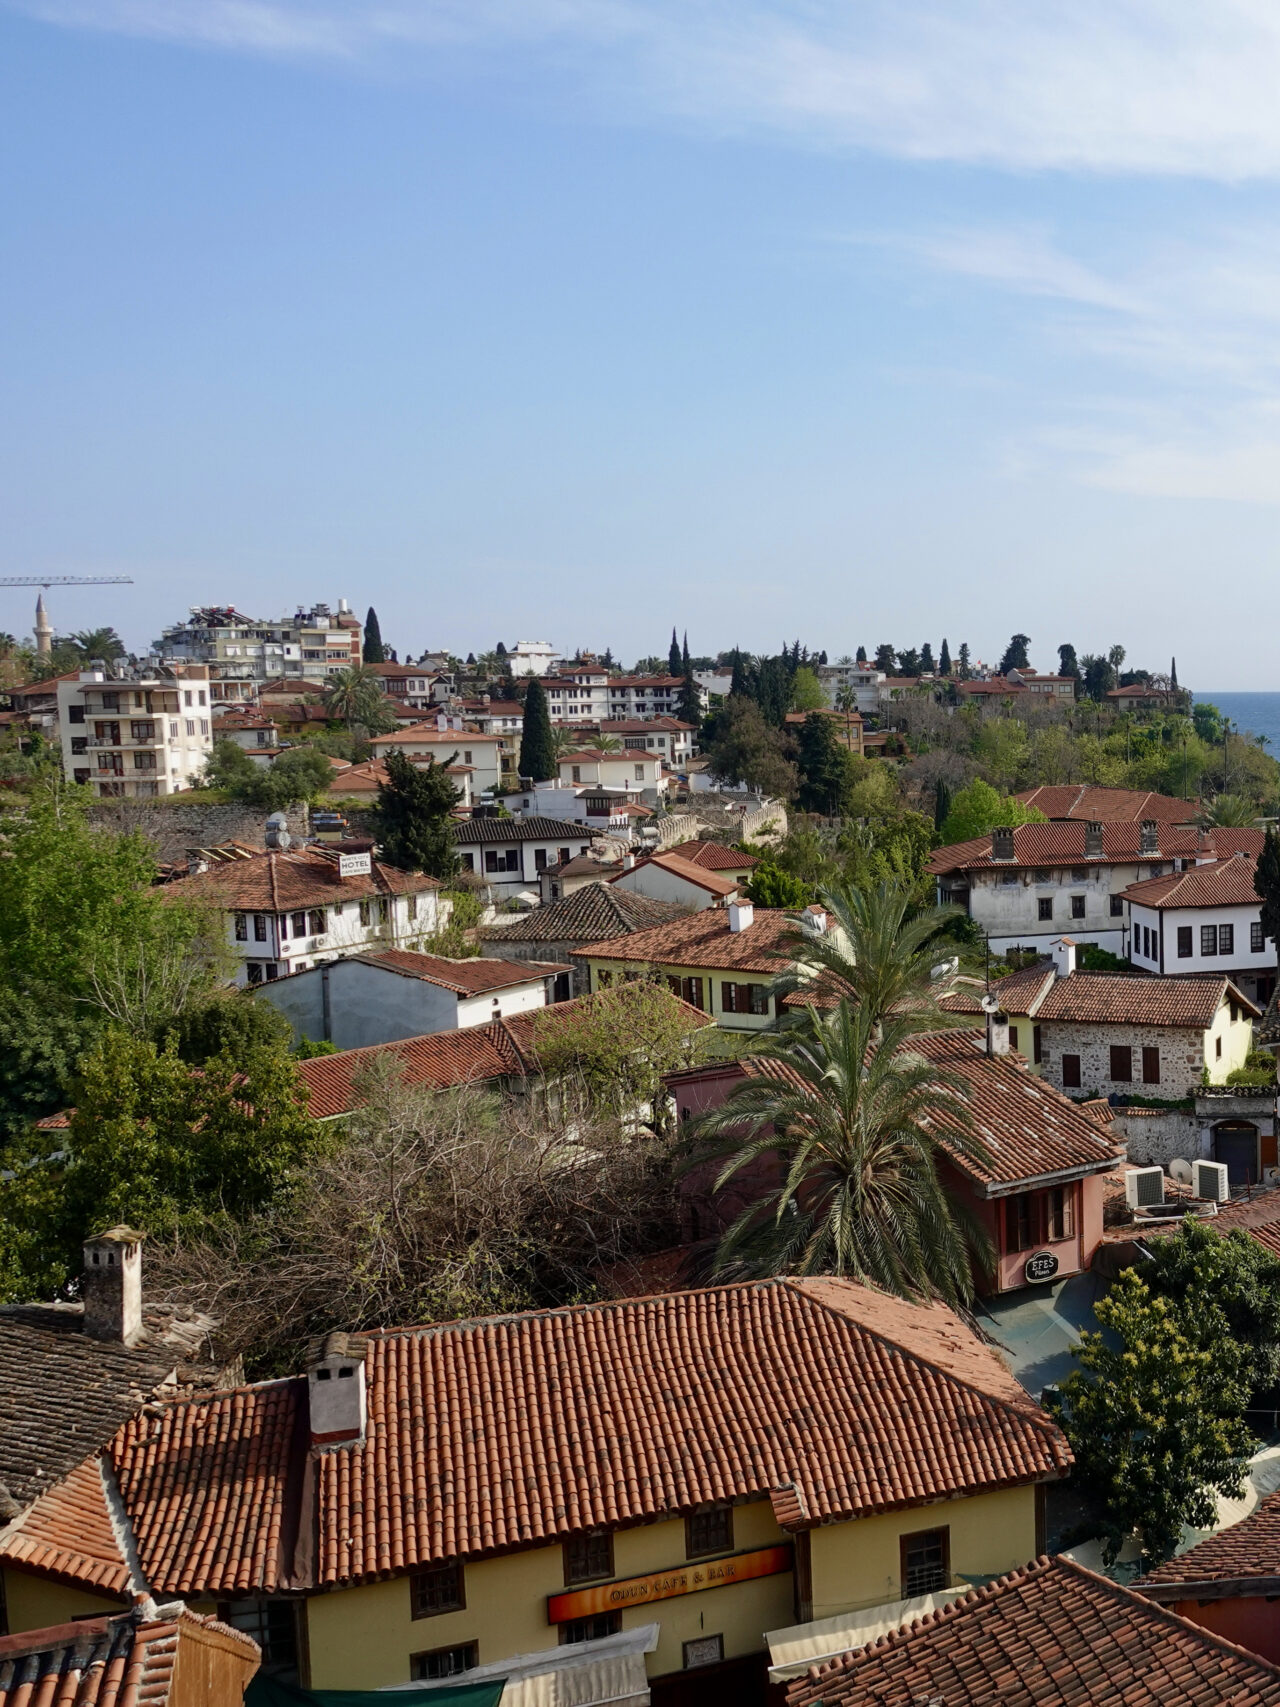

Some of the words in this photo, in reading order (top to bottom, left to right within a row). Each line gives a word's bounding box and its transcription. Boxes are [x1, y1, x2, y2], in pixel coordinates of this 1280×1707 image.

[342, 860, 369, 869] HOTEL
[1032, 1258, 1054, 1271] EFES
[611, 1584, 648, 1601] ODUN
[653, 1574, 688, 1593] CAFE
[693, 1571, 705, 1584] &
[707, 1564, 737, 1581] BAR
